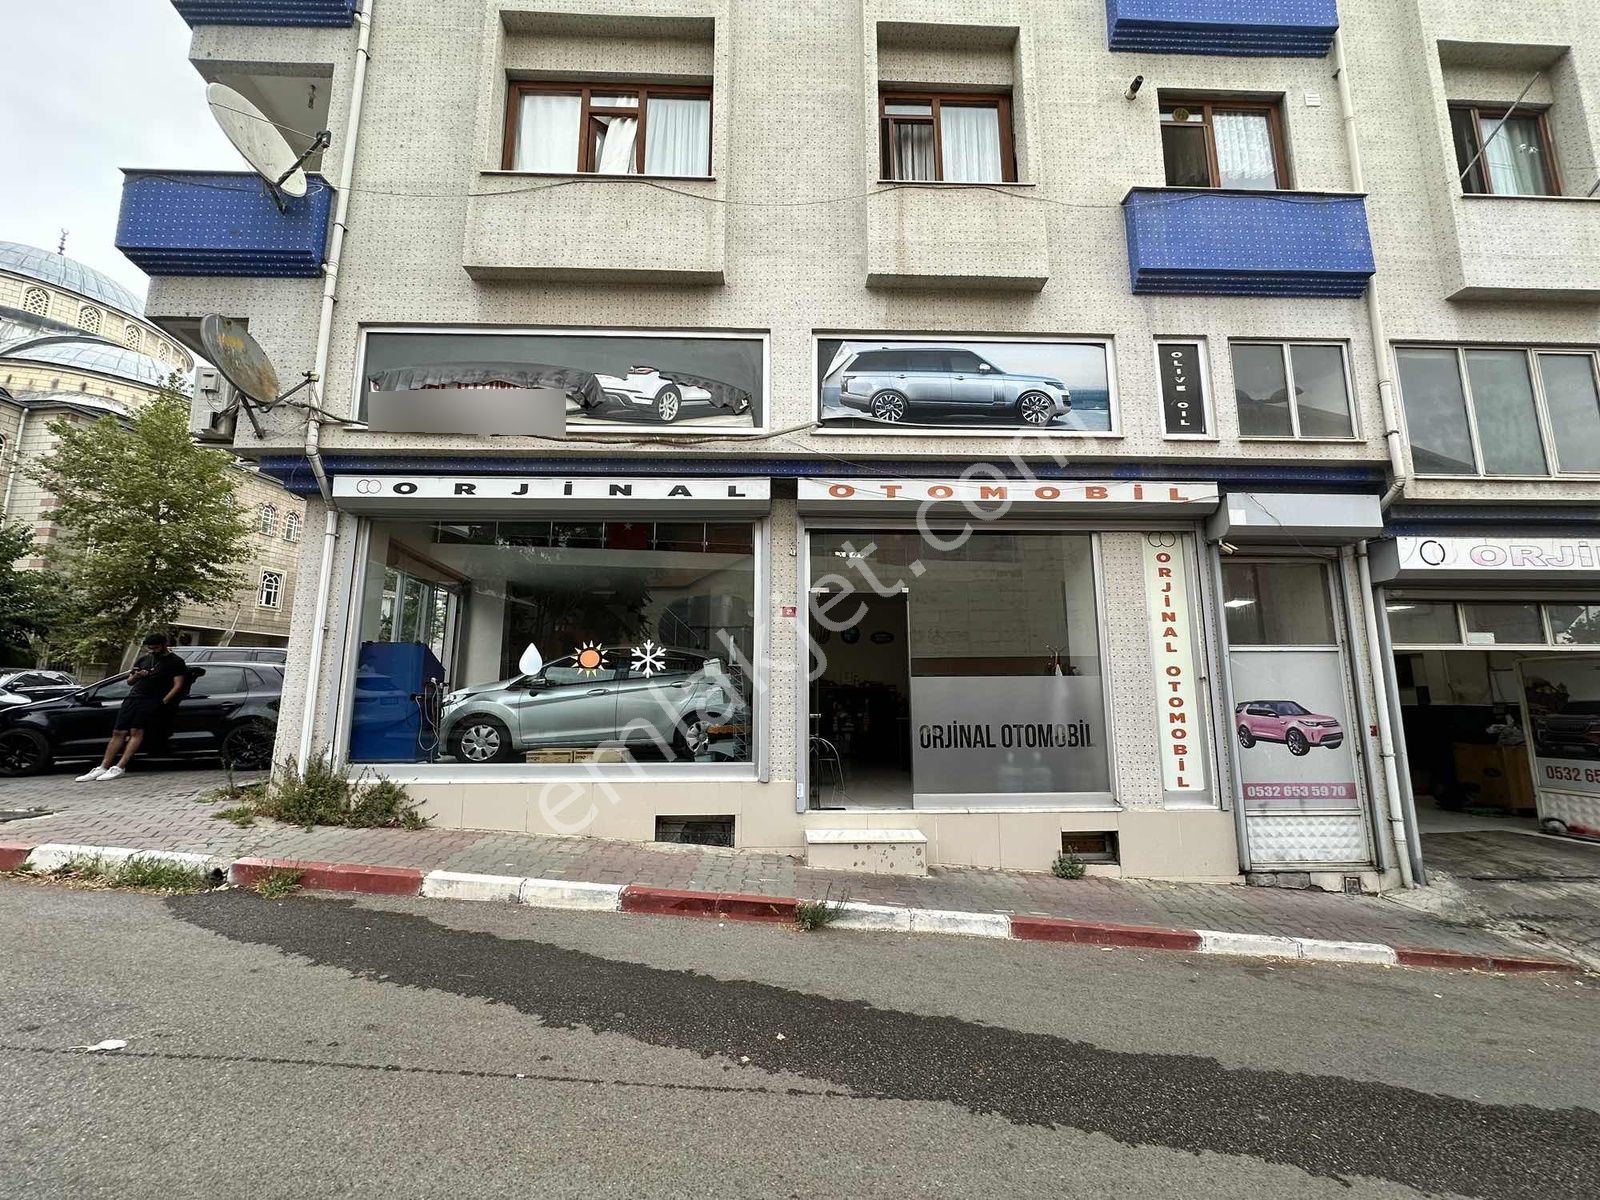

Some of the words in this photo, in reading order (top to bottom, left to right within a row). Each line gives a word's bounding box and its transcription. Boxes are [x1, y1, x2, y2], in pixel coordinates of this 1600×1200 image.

[1170, 351, 1187, 391] OLIVE
[1176, 401, 1191, 426] OIL
[392, 480, 747, 498] ORJİNAL
[828, 483, 1190, 502] OTOMOBİL
[1470, 540, 1600, 567] ORJİ
[1155, 552, 1178, 653] ORJİNAL
[919, 720, 997, 749] ORJİNAL
[1001, 719, 1097, 748] OTOMOBİL
[1165, 665, 1190, 788] OTOMOBİL
[1546, 765, 1582, 782] 0532
[1247, 785, 1281, 797] 0532
[1283, 785, 1309, 797] 653
